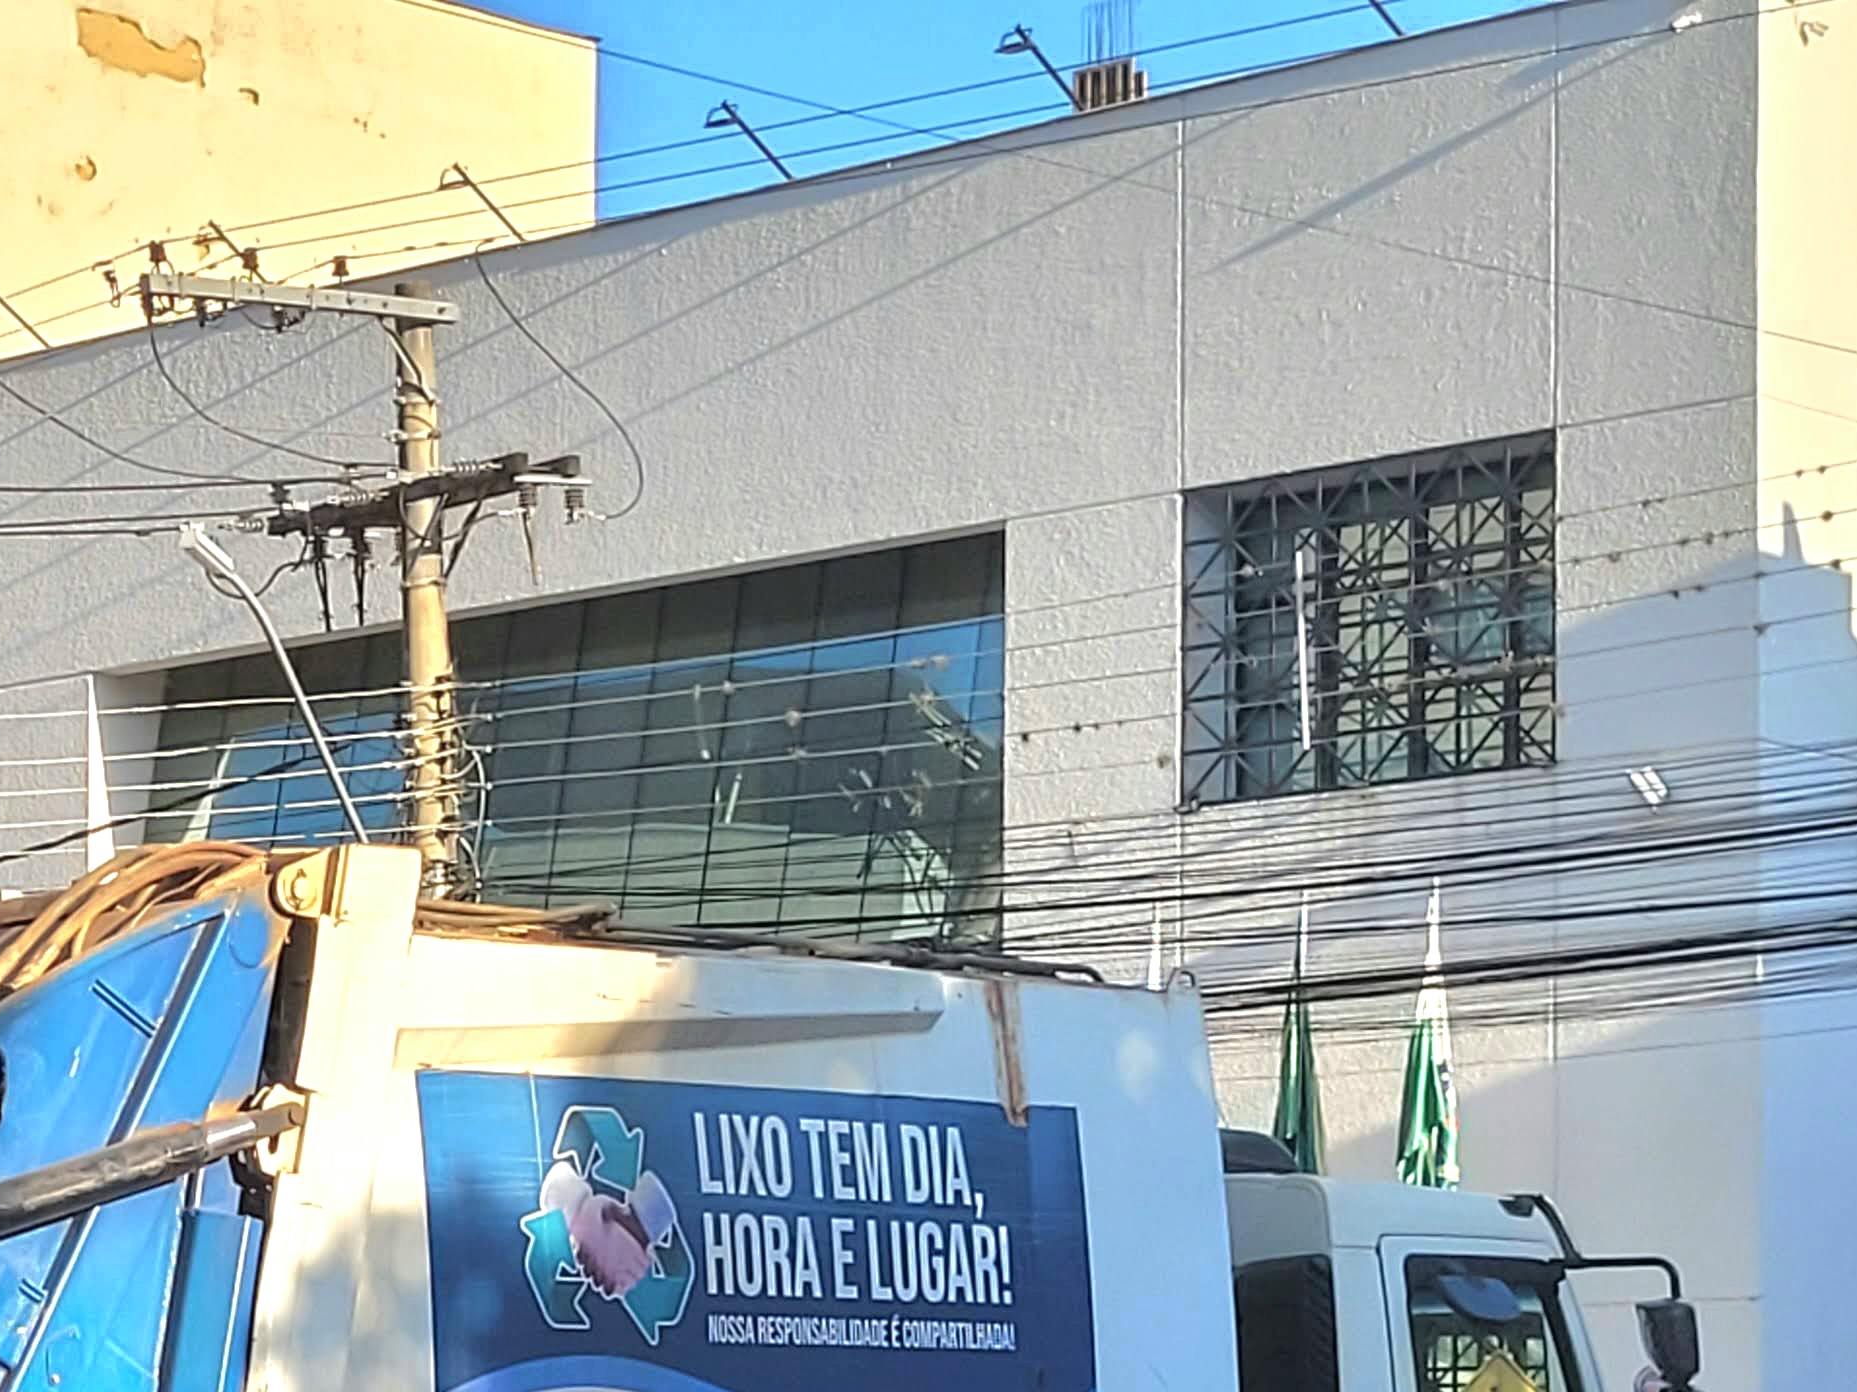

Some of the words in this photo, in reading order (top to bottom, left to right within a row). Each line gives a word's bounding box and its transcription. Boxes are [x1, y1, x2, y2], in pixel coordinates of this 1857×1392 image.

[693, 1111, 793, 1198] LIXO
[799, 1118, 893, 1203] TEM
[899, 1123, 984, 1219] DIA,
[702, 1212, 823, 1299] HORA
[831, 1217, 859, 1300] E
[866, 1219, 1013, 1305] LUGAR!
[708, 1314, 754, 1345] NOSSA
[757, 1316, 889, 1349] RESPONSABILIDADE
[891, 1313, 900, 1349] É
[902, 1320, 1017, 1352] COMPARTILHADA!
